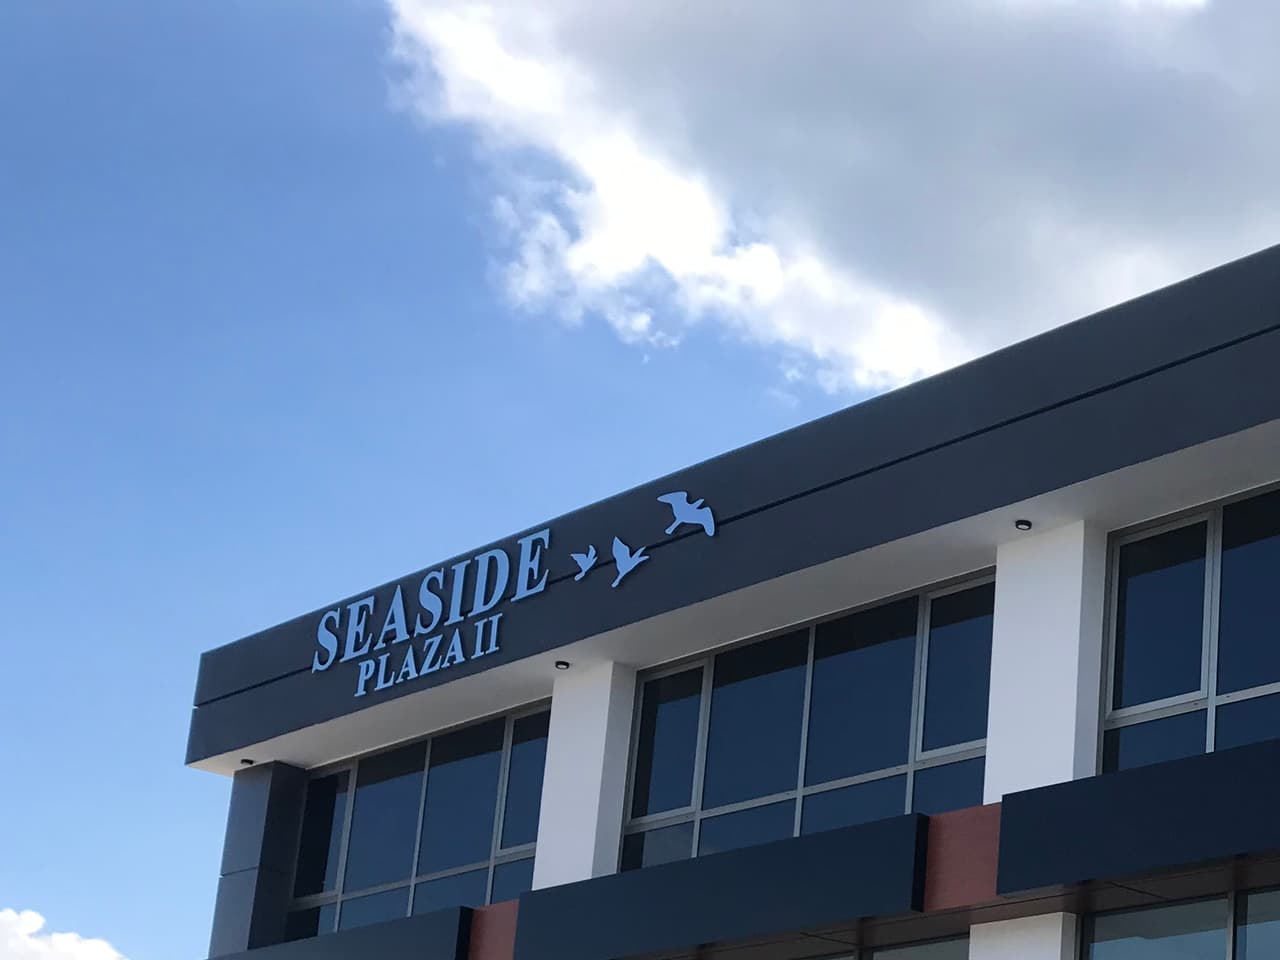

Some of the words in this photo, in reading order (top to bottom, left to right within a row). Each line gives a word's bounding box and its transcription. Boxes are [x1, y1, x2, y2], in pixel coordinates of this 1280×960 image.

[311, 528, 550, 673] SEASIDE
[354, 628, 465, 697] PLAZA
[471, 613, 503, 660] II
